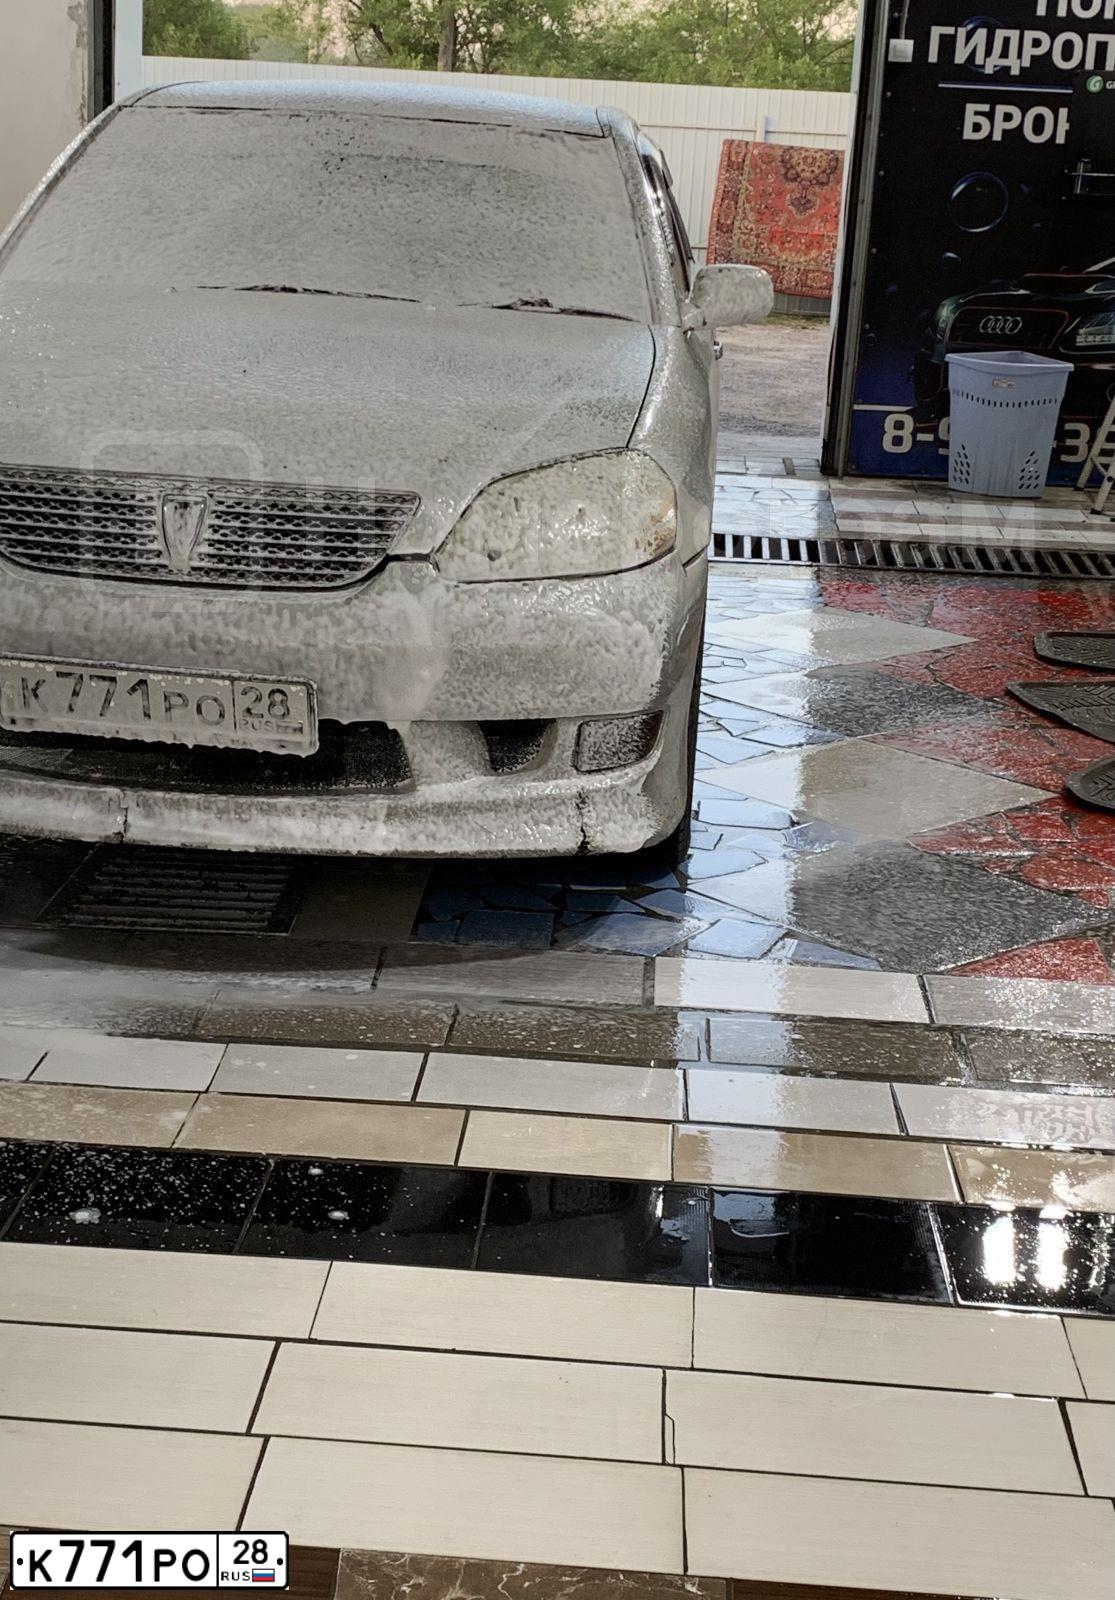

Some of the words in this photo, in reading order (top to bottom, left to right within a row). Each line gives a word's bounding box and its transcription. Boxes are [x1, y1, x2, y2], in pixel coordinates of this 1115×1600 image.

[928, 25, 1115, 75] ГИДРОП
[20, 671, 226, 726] К771РО
[241, 686, 290, 720] 28
